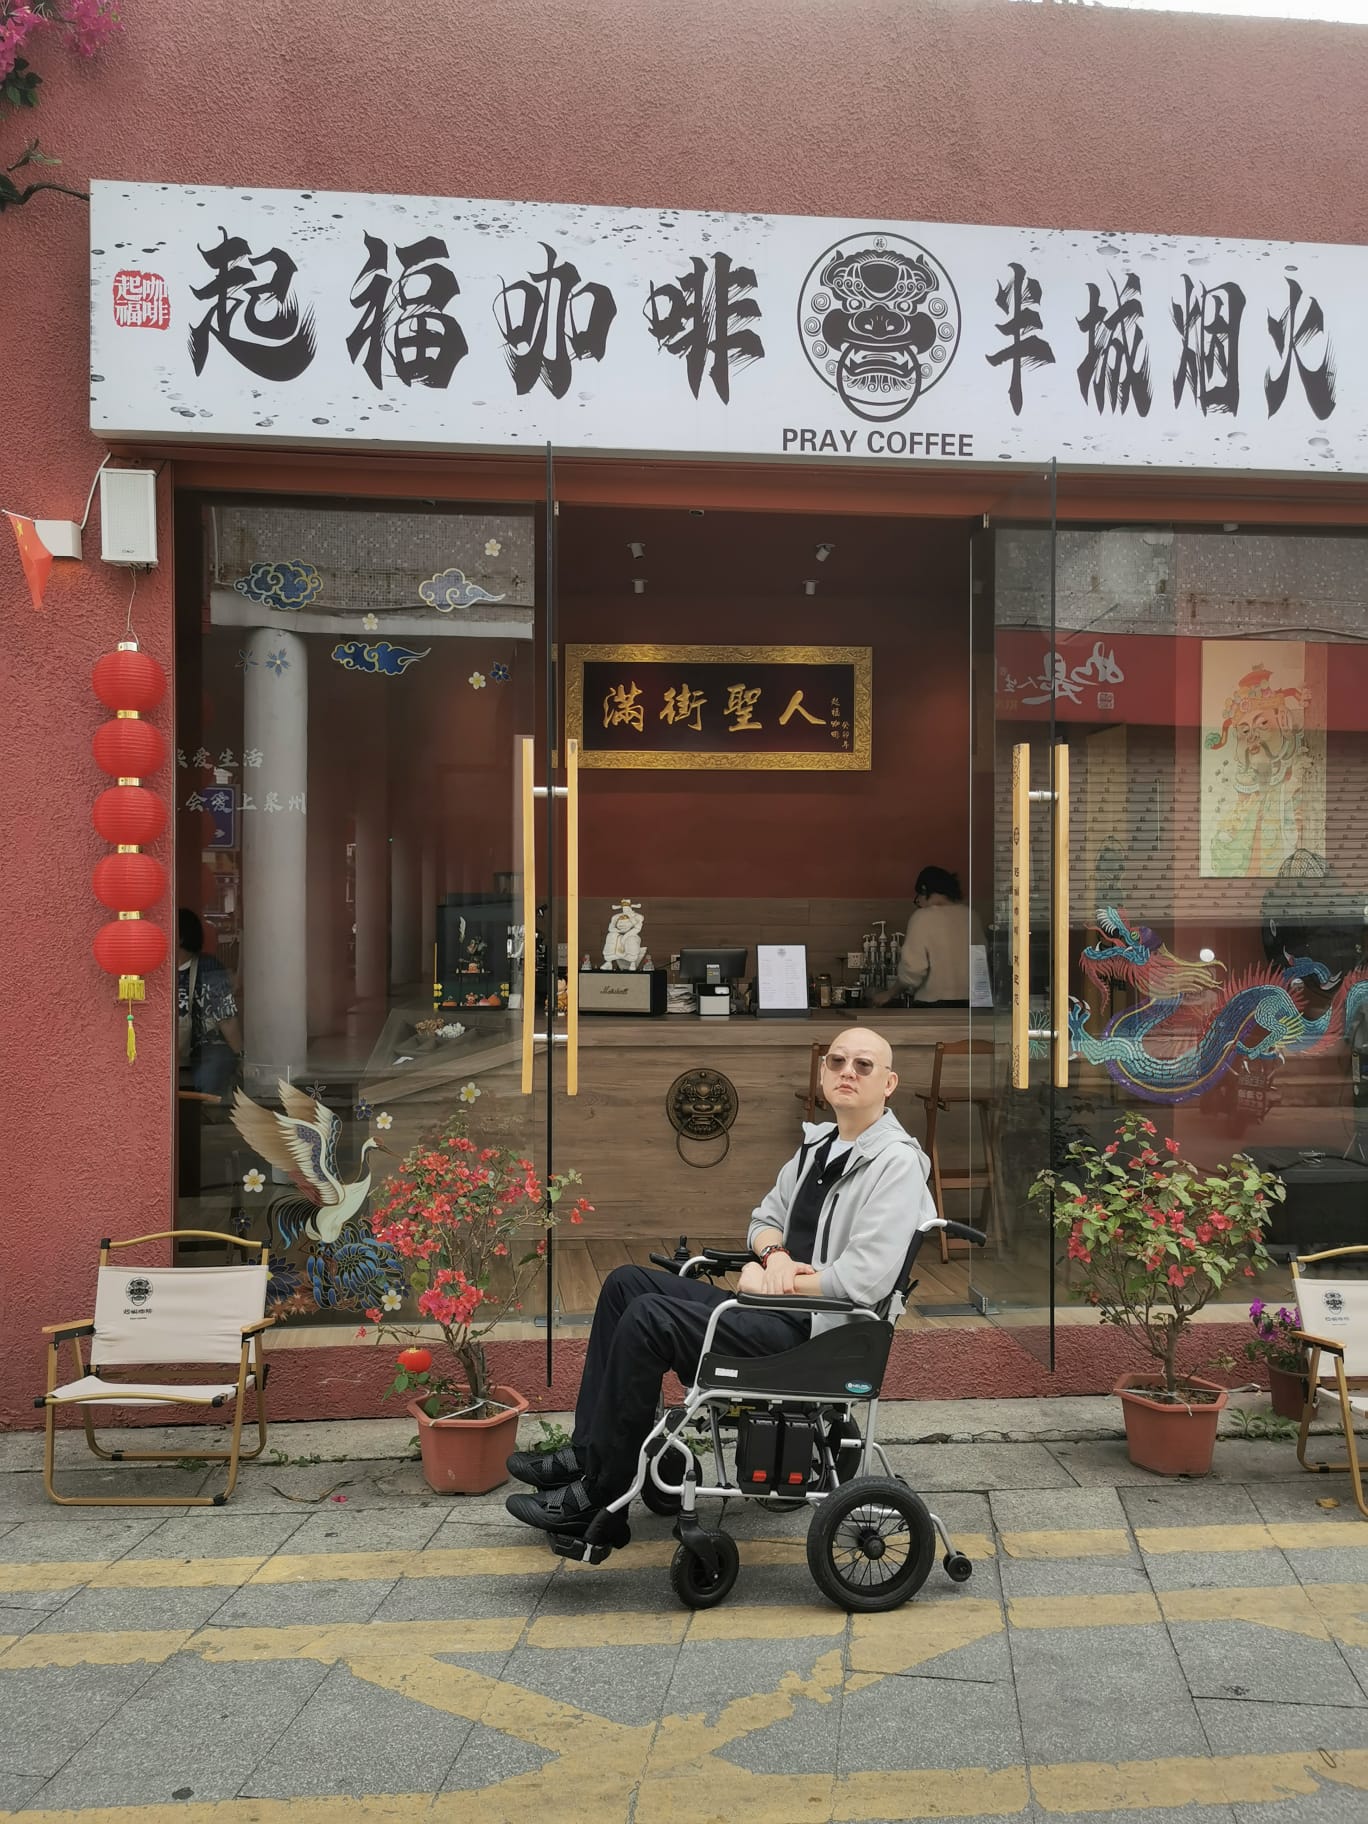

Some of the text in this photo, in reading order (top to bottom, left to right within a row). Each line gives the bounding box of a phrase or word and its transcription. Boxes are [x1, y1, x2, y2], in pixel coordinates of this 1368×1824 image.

[188, 225, 766, 405] 起福咖啡
[985, 261, 1338, 420] 半城烟火
[782, 428, 974, 457] PRAY COFFEE
